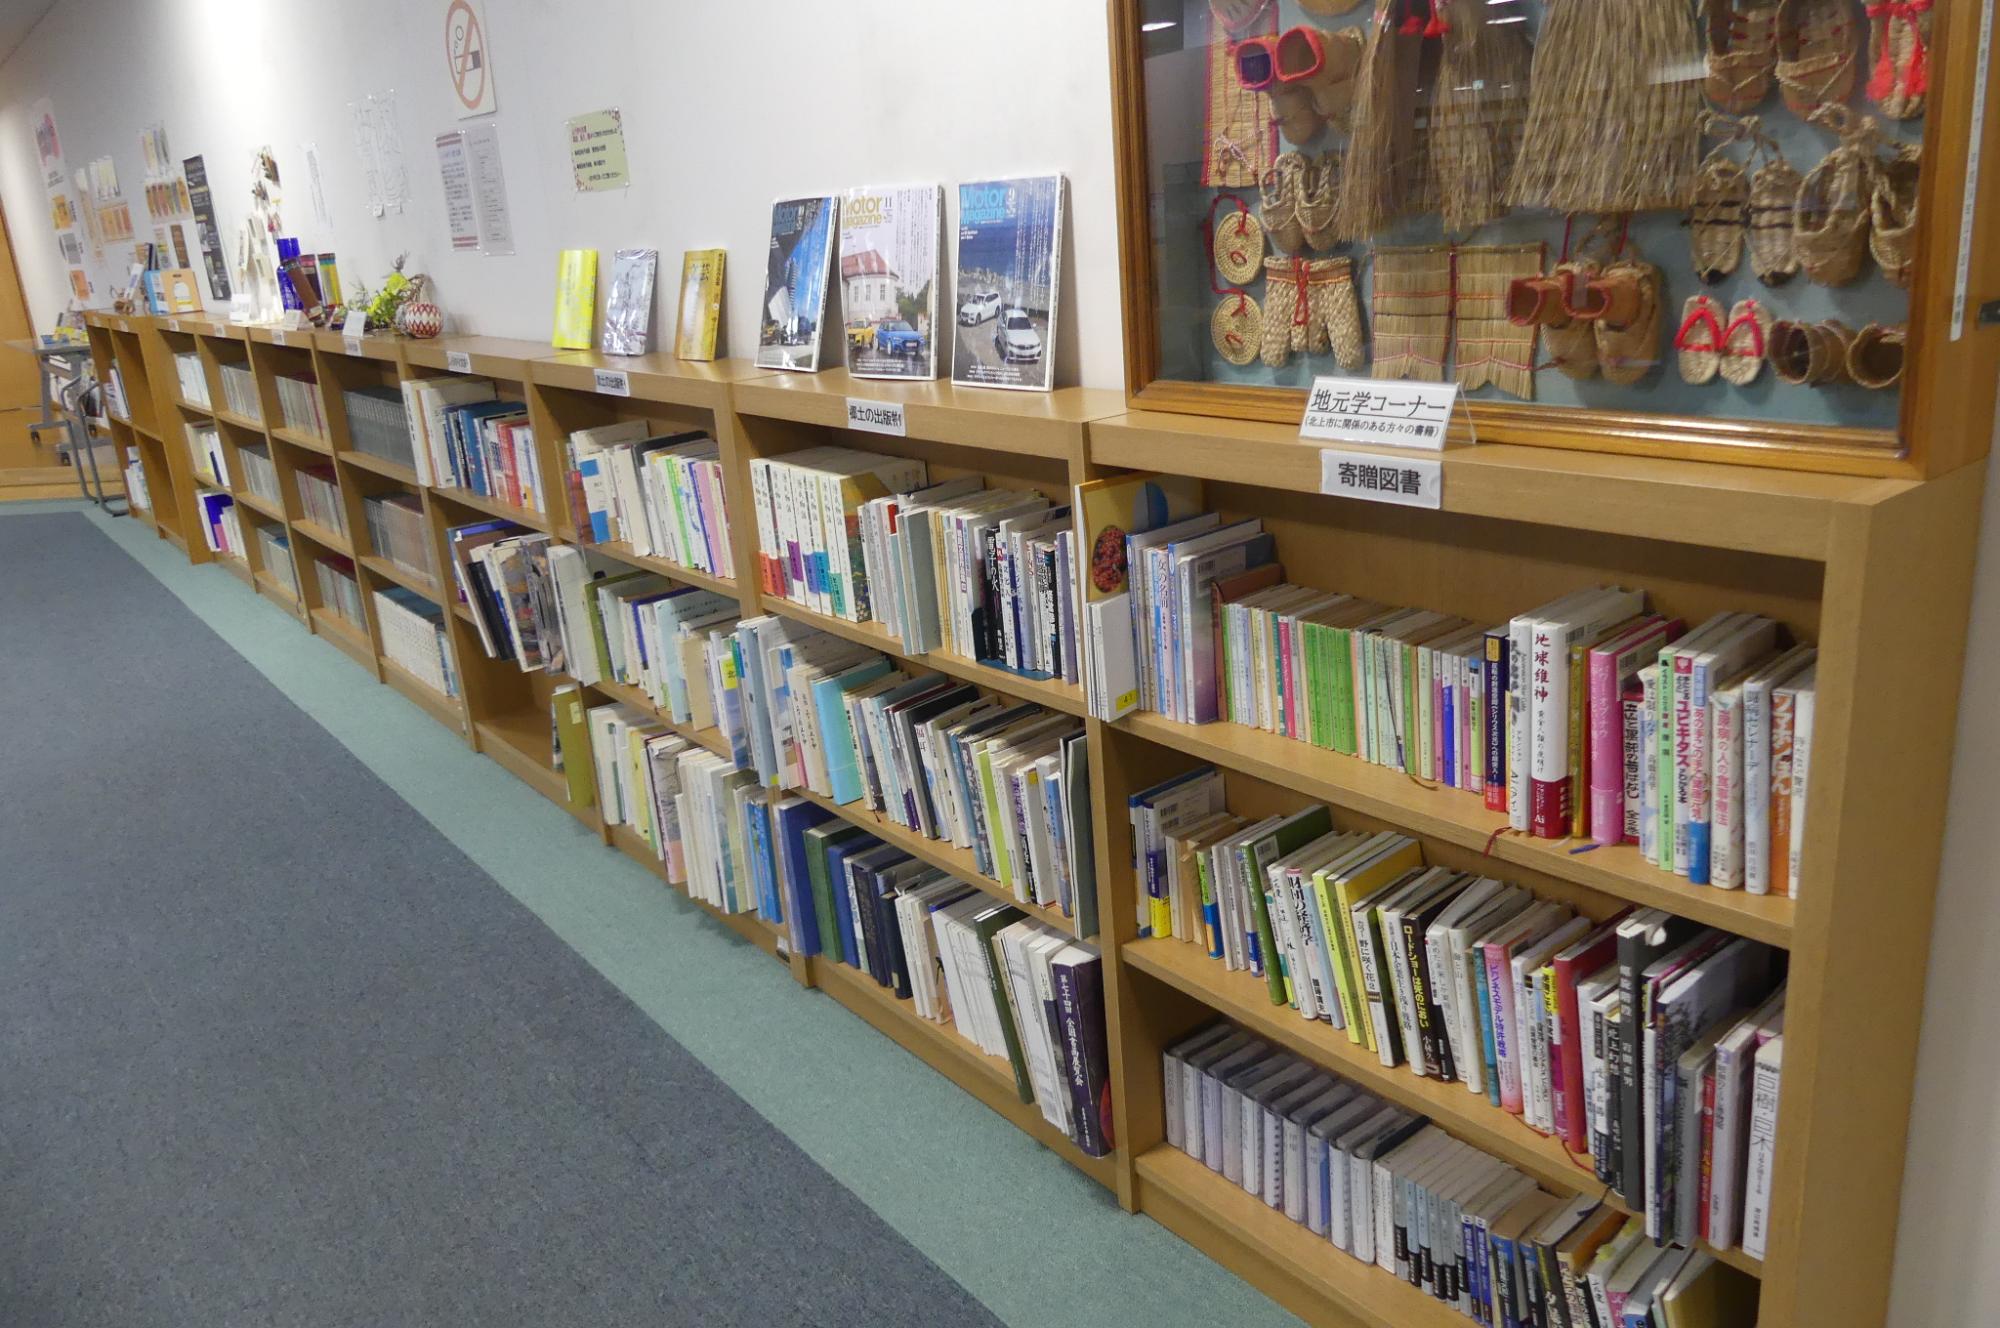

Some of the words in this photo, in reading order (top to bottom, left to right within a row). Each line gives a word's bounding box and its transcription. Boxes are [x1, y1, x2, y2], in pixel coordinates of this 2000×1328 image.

[842, 195, 882, 218] Motor
[960, 186, 1005, 209] Motor
[960, 207, 1005, 225] Magazine
[1311, 388, 1447, 418] 地元学コーナー
[1338, 462, 1422, 496] 寄贈図書
[1534, 633, 1551, 703] 地球維神
